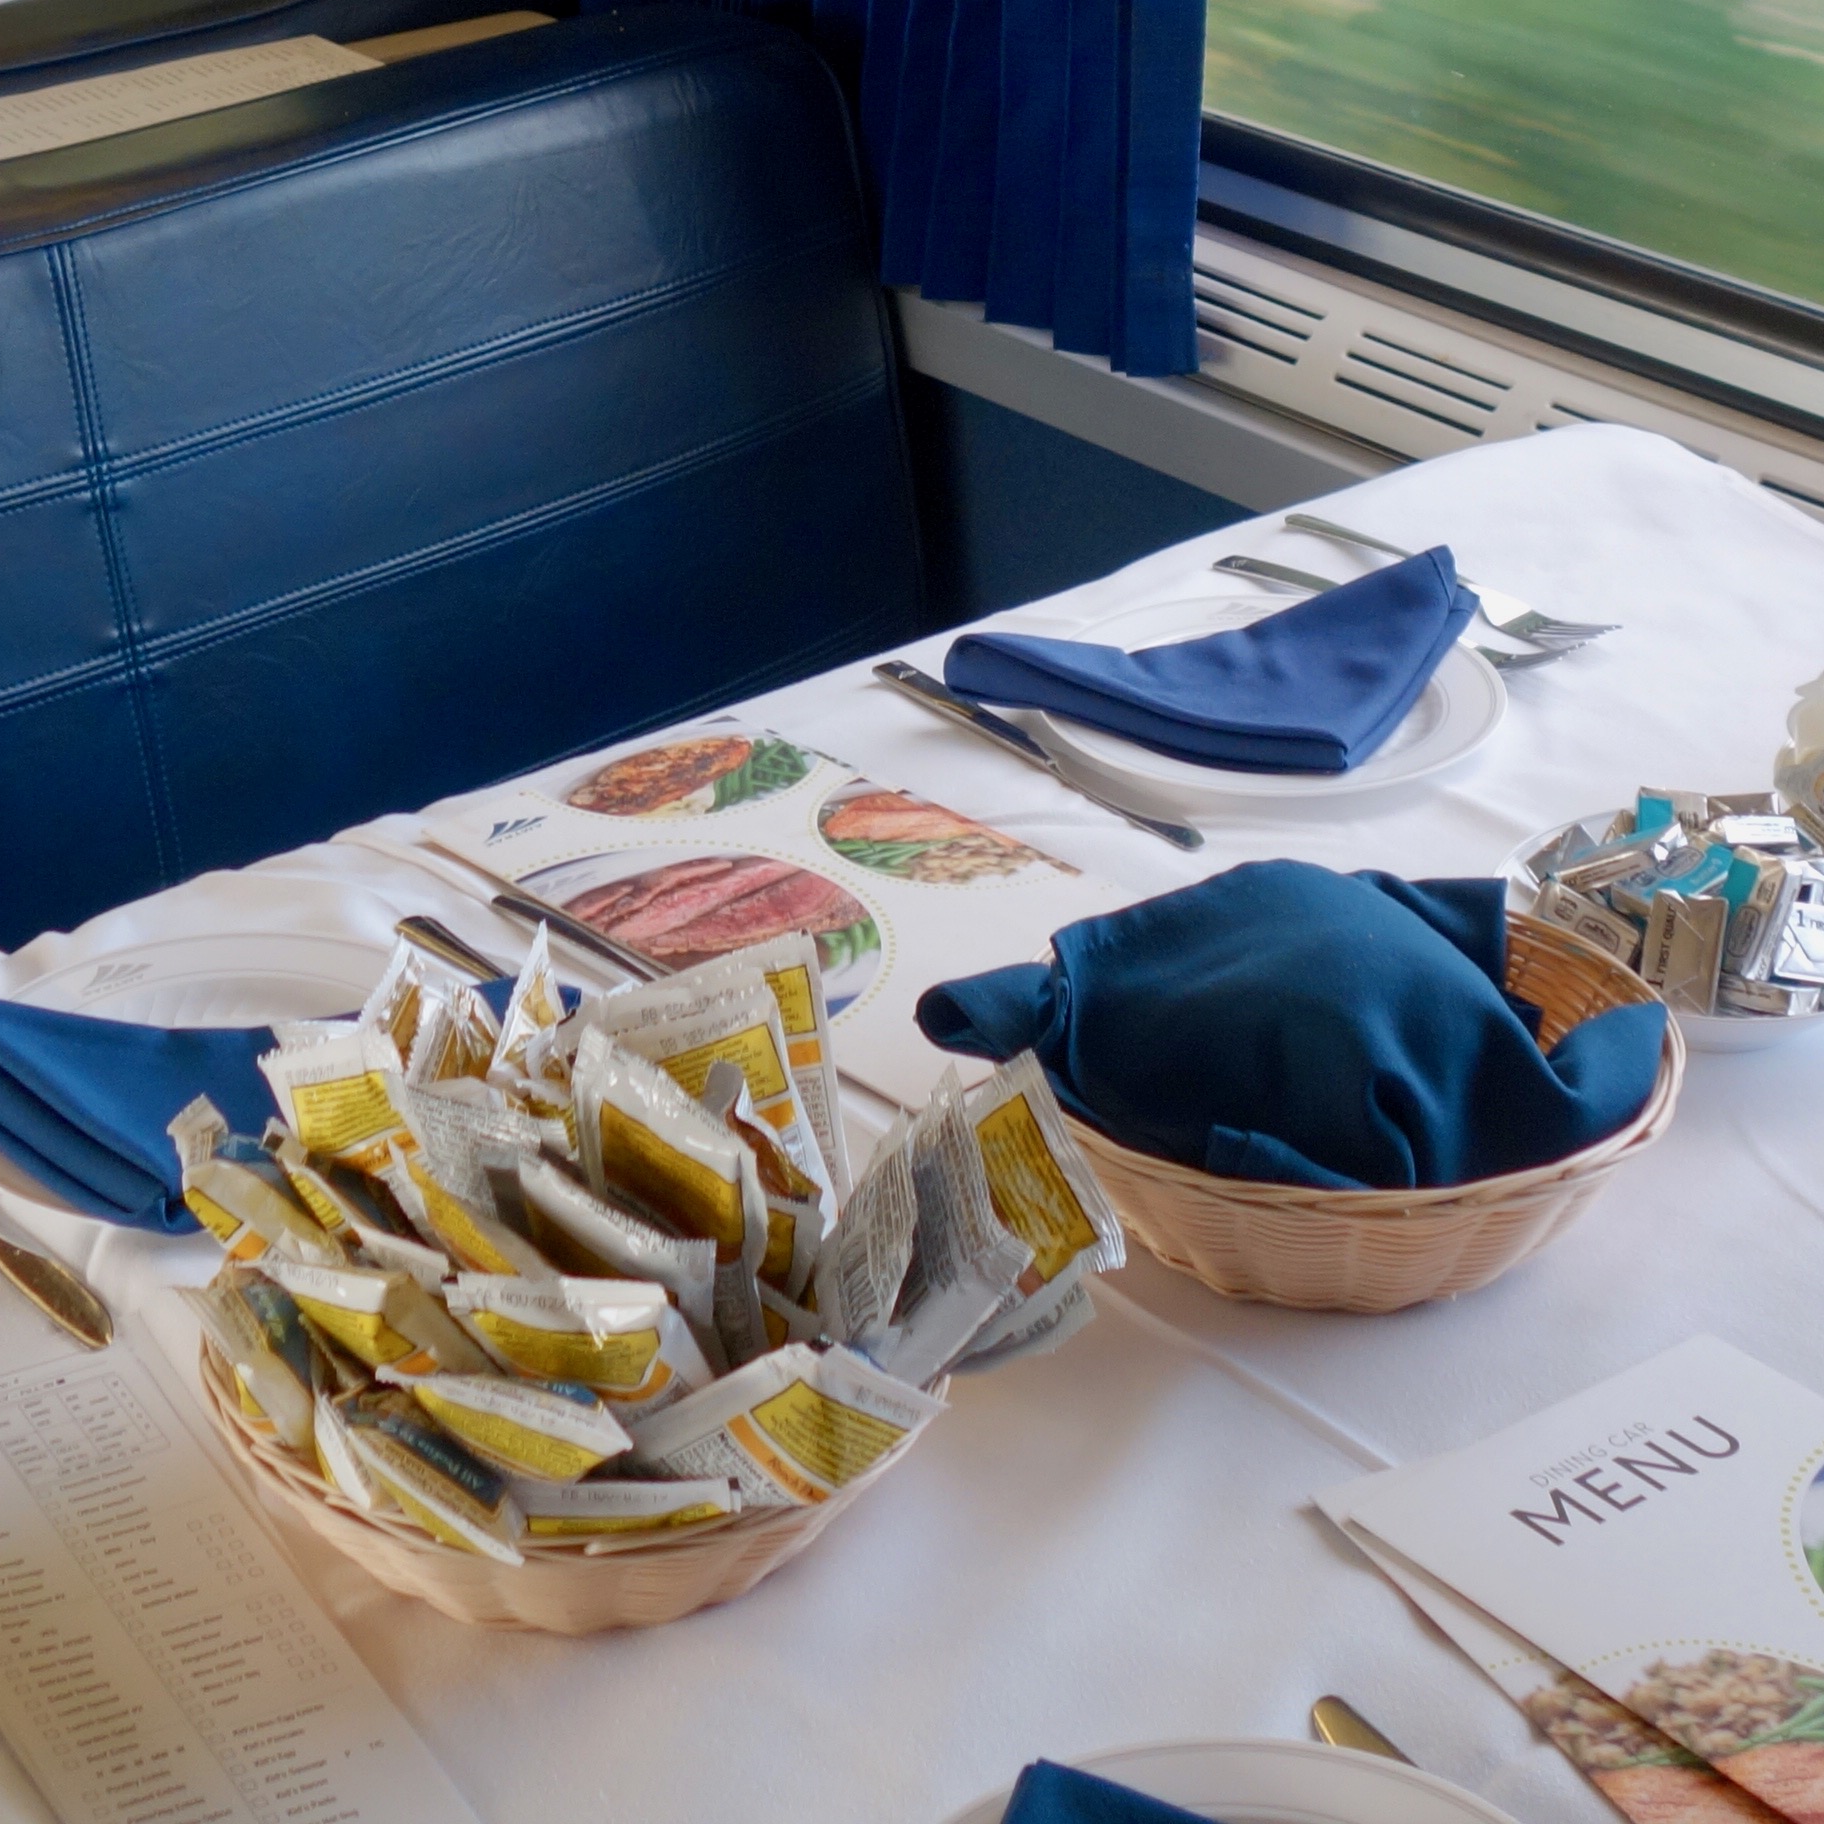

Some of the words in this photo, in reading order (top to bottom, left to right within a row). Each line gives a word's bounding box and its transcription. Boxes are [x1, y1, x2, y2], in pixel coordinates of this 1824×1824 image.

[1797, 910, 1806, 927] 1
[1508, 1414, 1740, 1547] MENU
[1530, 1444, 1607, 1488] DINING
[1608, 1421, 1654, 1448] CAR
